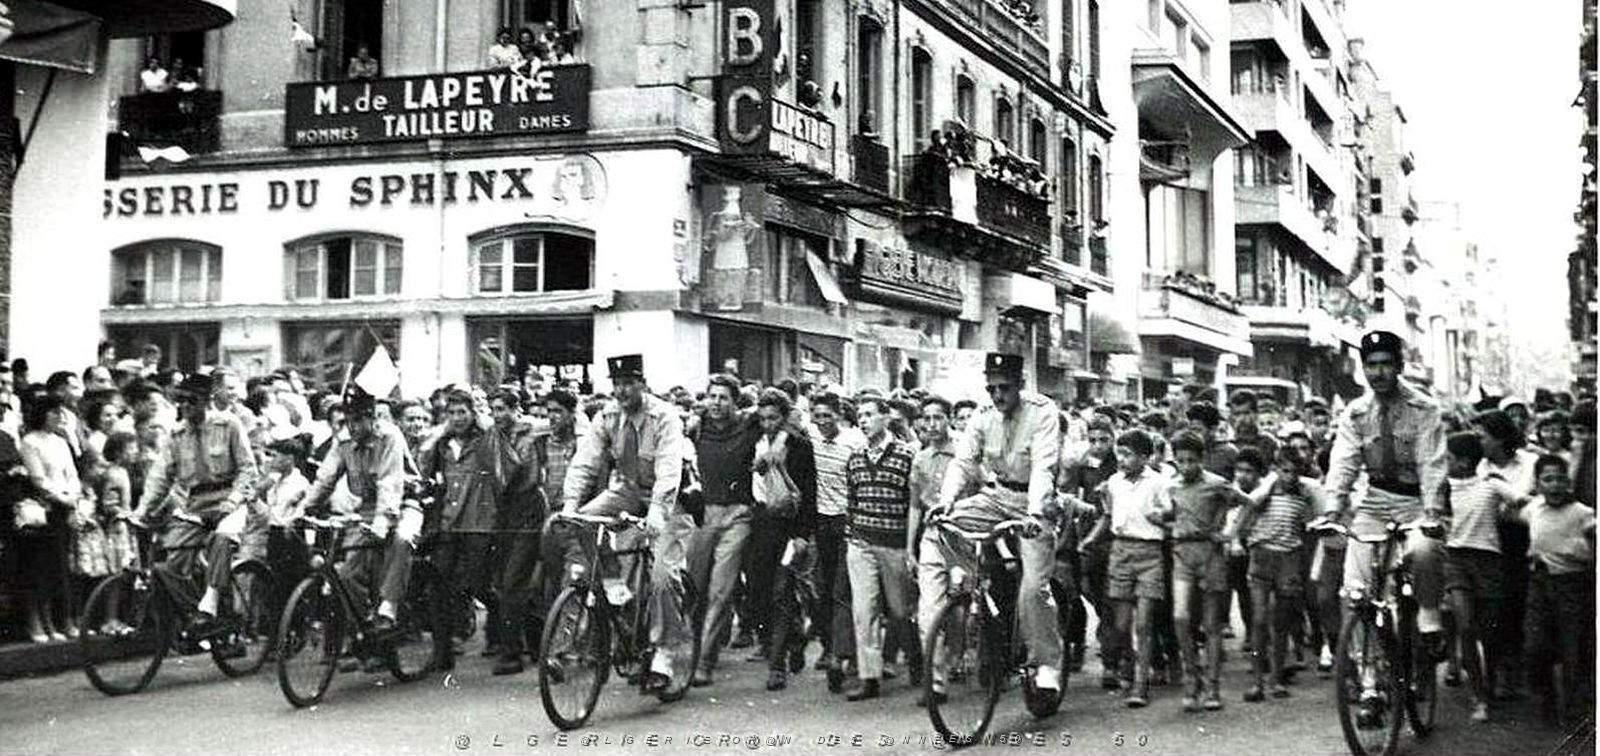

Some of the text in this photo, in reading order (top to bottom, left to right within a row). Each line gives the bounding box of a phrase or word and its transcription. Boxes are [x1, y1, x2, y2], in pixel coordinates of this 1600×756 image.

[403, 71, 555, 110] LAPEYRE
[296, 109, 572, 144] HOMMES TAILLEUR DAMES
[268, 179, 319, 210] DU
[349, 168, 534, 208] SPHINX
